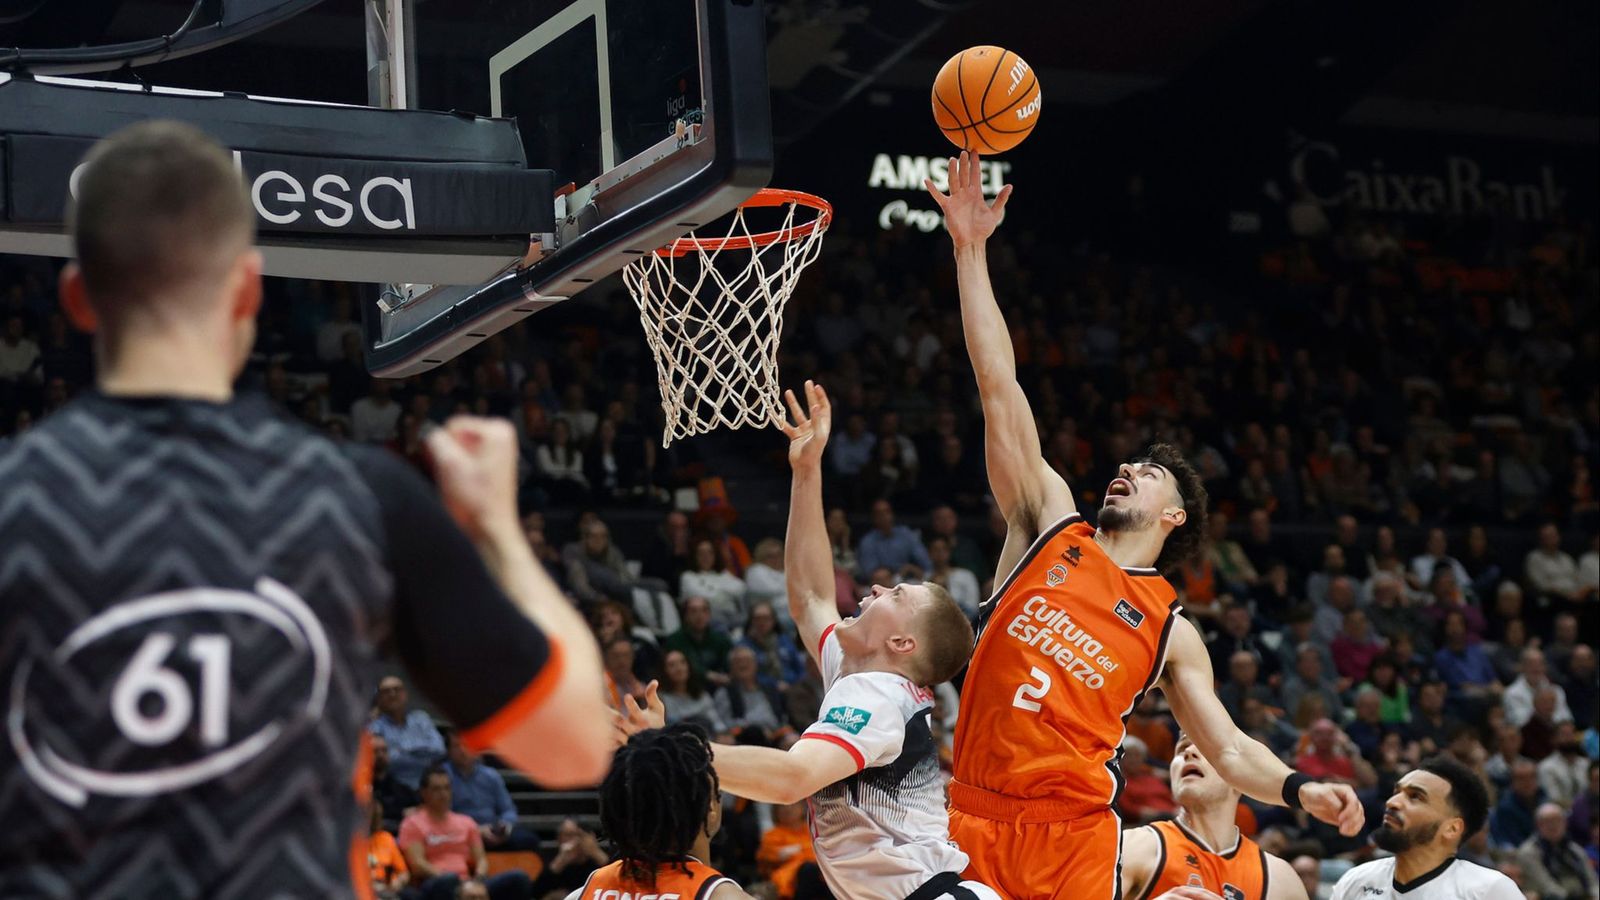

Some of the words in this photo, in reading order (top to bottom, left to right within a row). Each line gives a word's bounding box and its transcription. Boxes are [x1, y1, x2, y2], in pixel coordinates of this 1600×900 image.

[868, 153, 1004, 195] AMSEL
[1289, 141, 1568, 223] CaixaBank
[1007, 614, 1105, 689] Esfuerzo
[1023, 596, 1104, 657] Cultura
[1096, 655, 1119, 673] del
[110, 632, 231, 748] 61
[1012, 666, 1052, 713] 2
